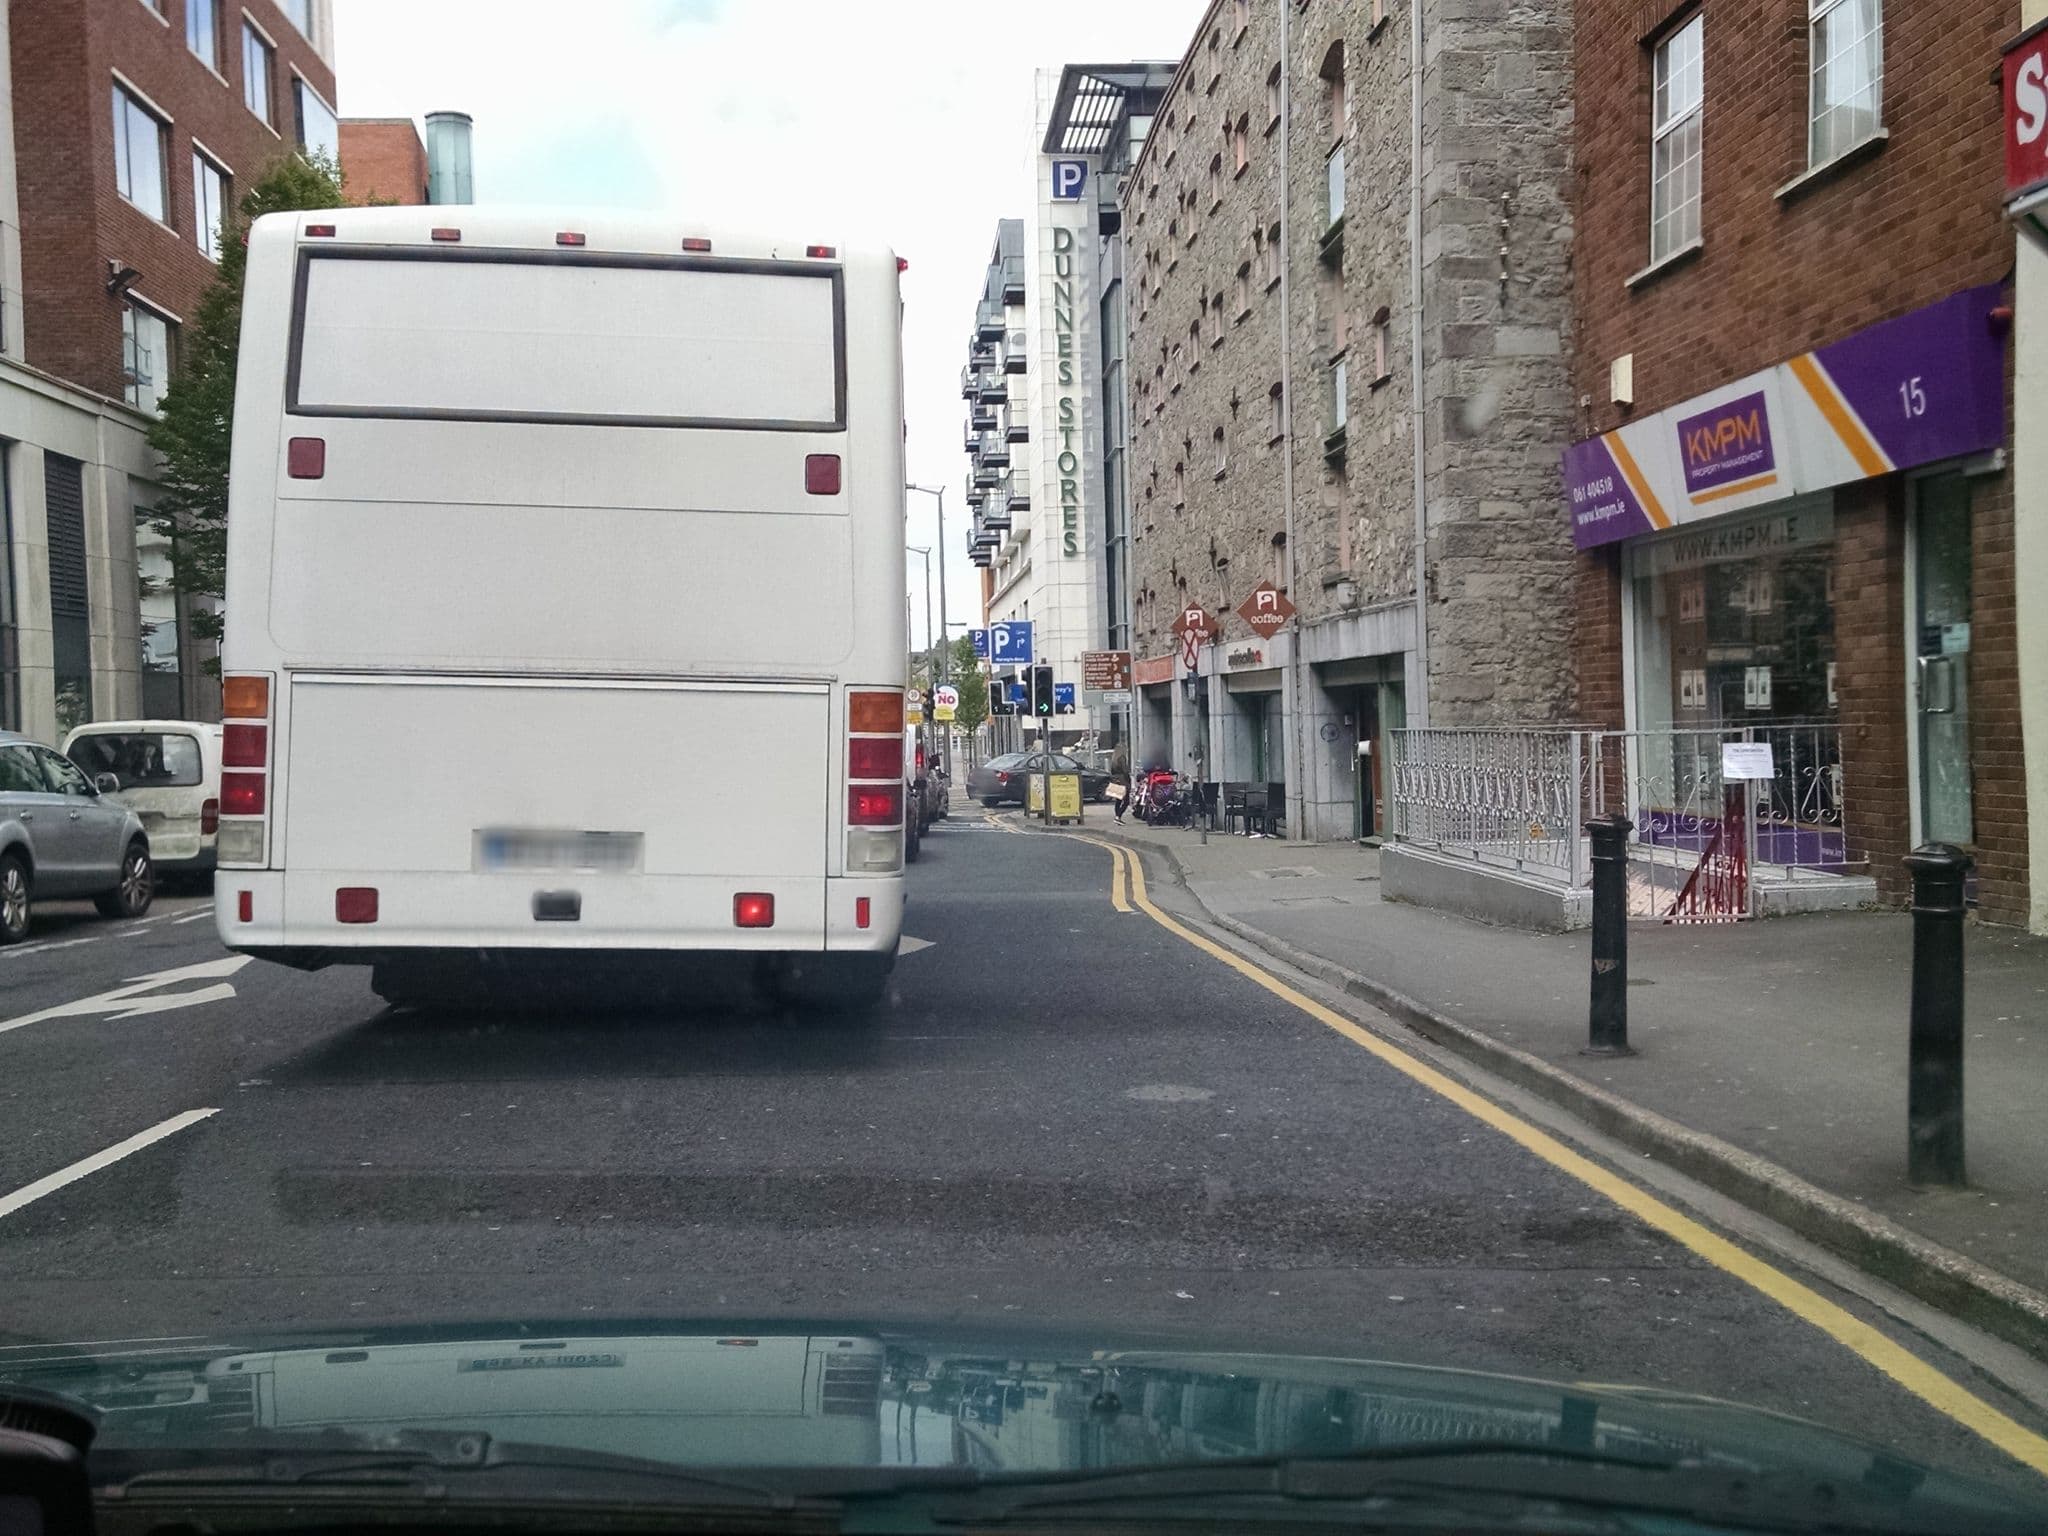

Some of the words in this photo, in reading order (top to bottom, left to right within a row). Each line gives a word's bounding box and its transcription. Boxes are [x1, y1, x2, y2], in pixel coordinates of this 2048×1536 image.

[2016, 51, 2048, 158] S
[1060, 164, 1081, 196] P
[1053, 227, 1073, 386] DUNNES
[1900, 376, 1926, 418] 15
[1686, 409, 1762, 465] KMPM
[1058, 397, 1077, 557] STORES
[1692, 463, 1720, 479] PROPERTY
[1720, 449, 1764, 469] MANAGEMENT
[1577, 498, 1626, 525] www.kmpm.ie
[1674, 517, 1799, 563] WWW.KMPM.IE
[1250, 613, 1284, 624] coffee
[975, 631, 983, 642] P
[995, 630, 1010, 655] P
[937, 695, 956, 704] NO
